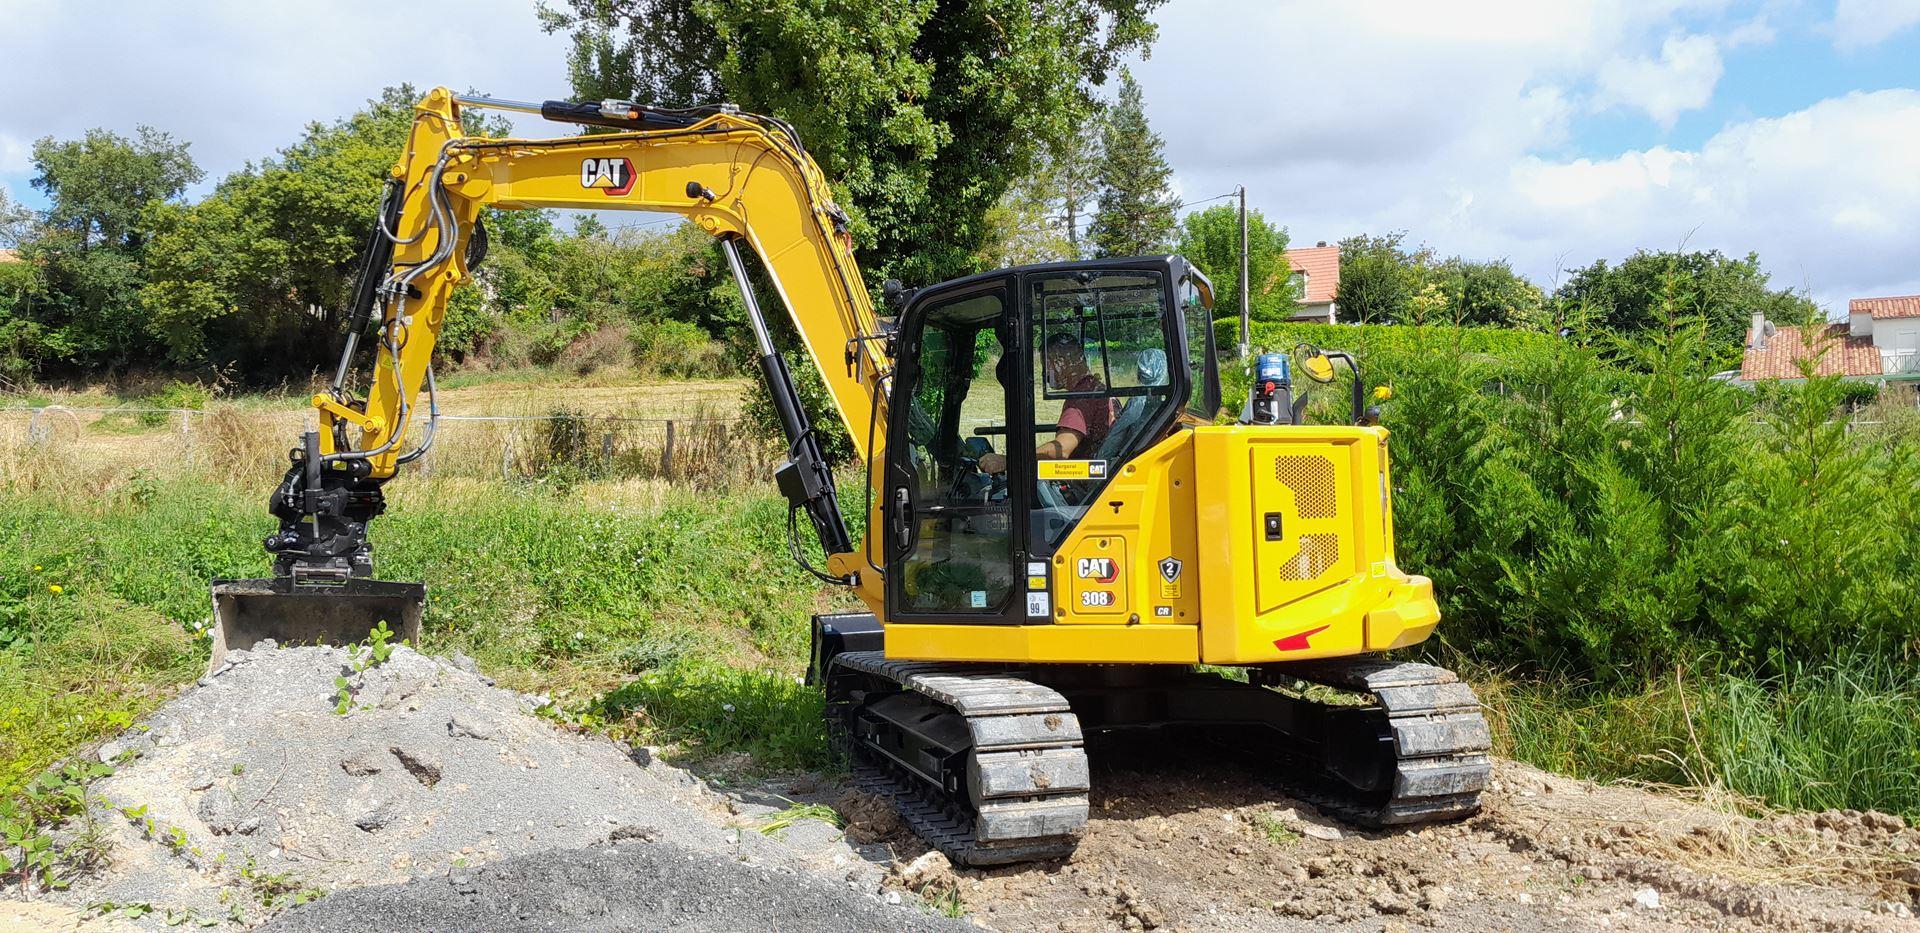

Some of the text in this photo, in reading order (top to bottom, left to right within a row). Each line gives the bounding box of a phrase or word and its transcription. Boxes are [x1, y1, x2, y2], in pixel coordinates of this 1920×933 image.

[582, 158, 624, 188] CAT
[1089, 464, 1105, 474] CAT
[1078, 558, 1110, 578] CAT
[1166, 562, 1174, 573] 2
[1081, 591, 1108, 606] 308
[1030, 602, 1040, 614] 99
[1157, 607, 1170, 616] CR
